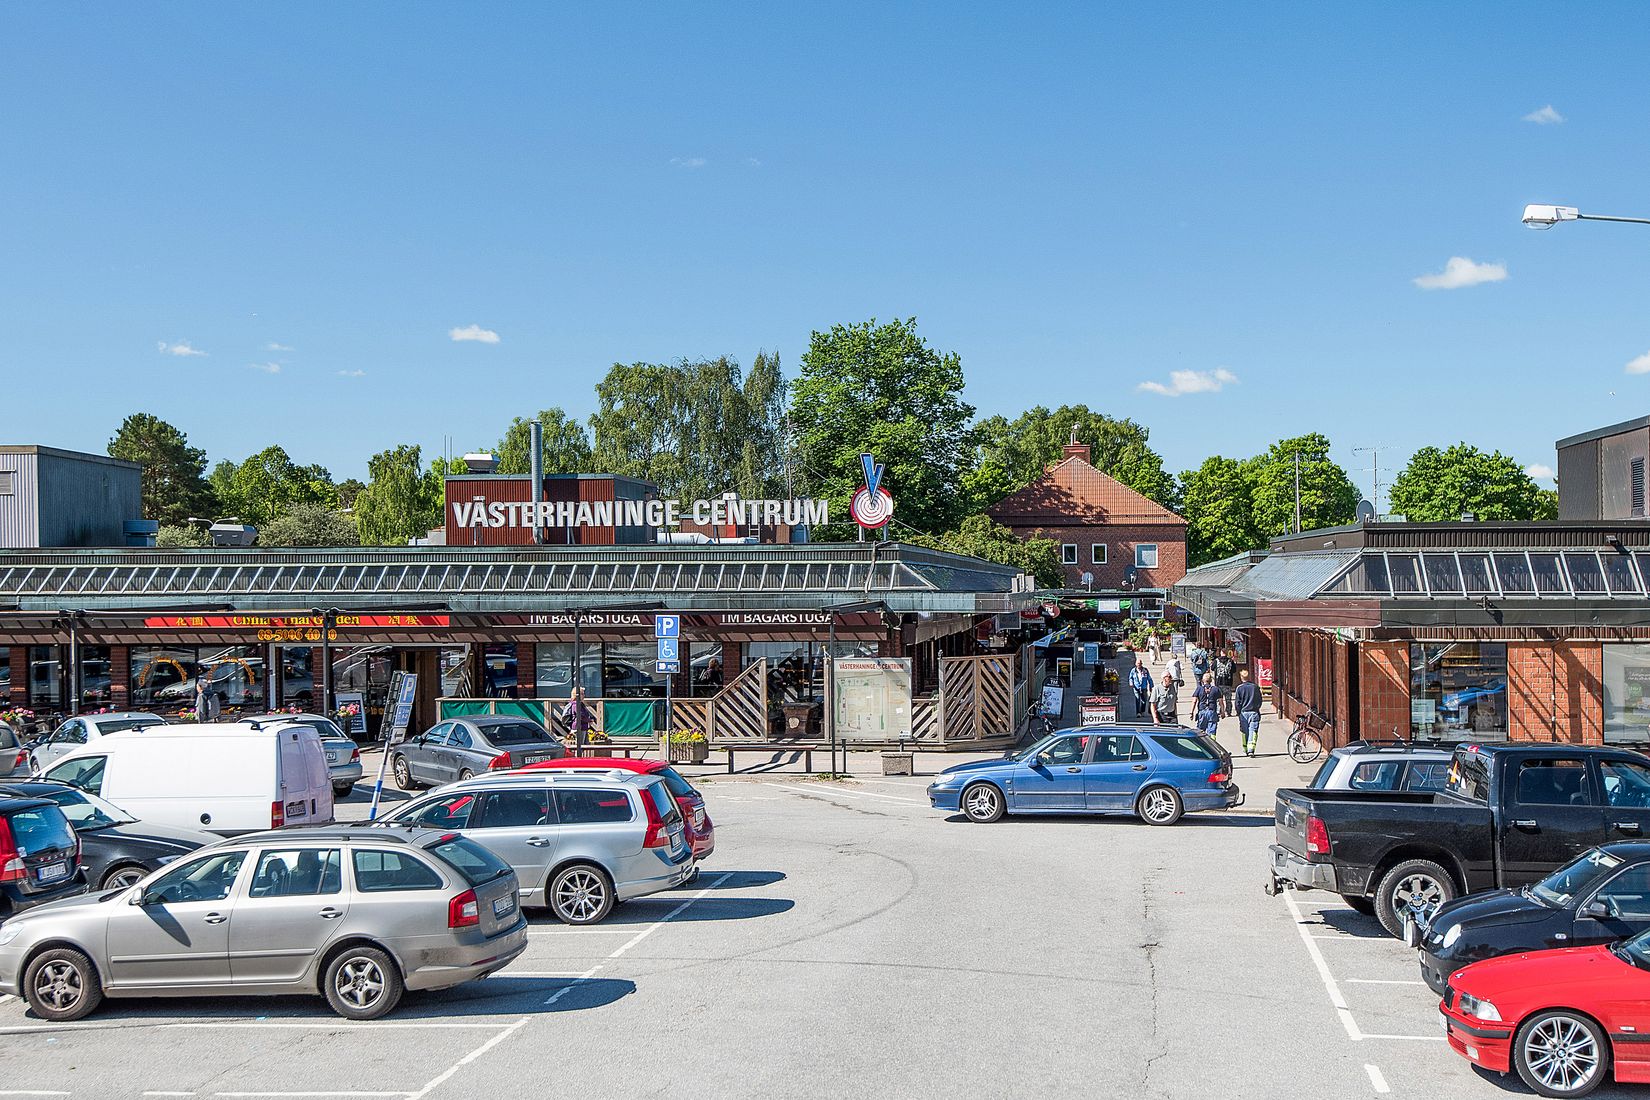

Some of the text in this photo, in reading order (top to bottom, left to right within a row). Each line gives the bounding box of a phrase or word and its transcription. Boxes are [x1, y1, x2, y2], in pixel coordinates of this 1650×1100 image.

[452, 495, 829, 528] VÄSTERHANINGE CENTRUM
[233, 616, 270, 625] China
[313, 615, 360, 625] Gden
[662, 617, 674, 635] P
[839, 662, 904, 670] VÄSTERHANINGE CENTRUM
[403, 677, 414, 701] P
[1082, 714, 1115, 722] NÖTFÄRS
